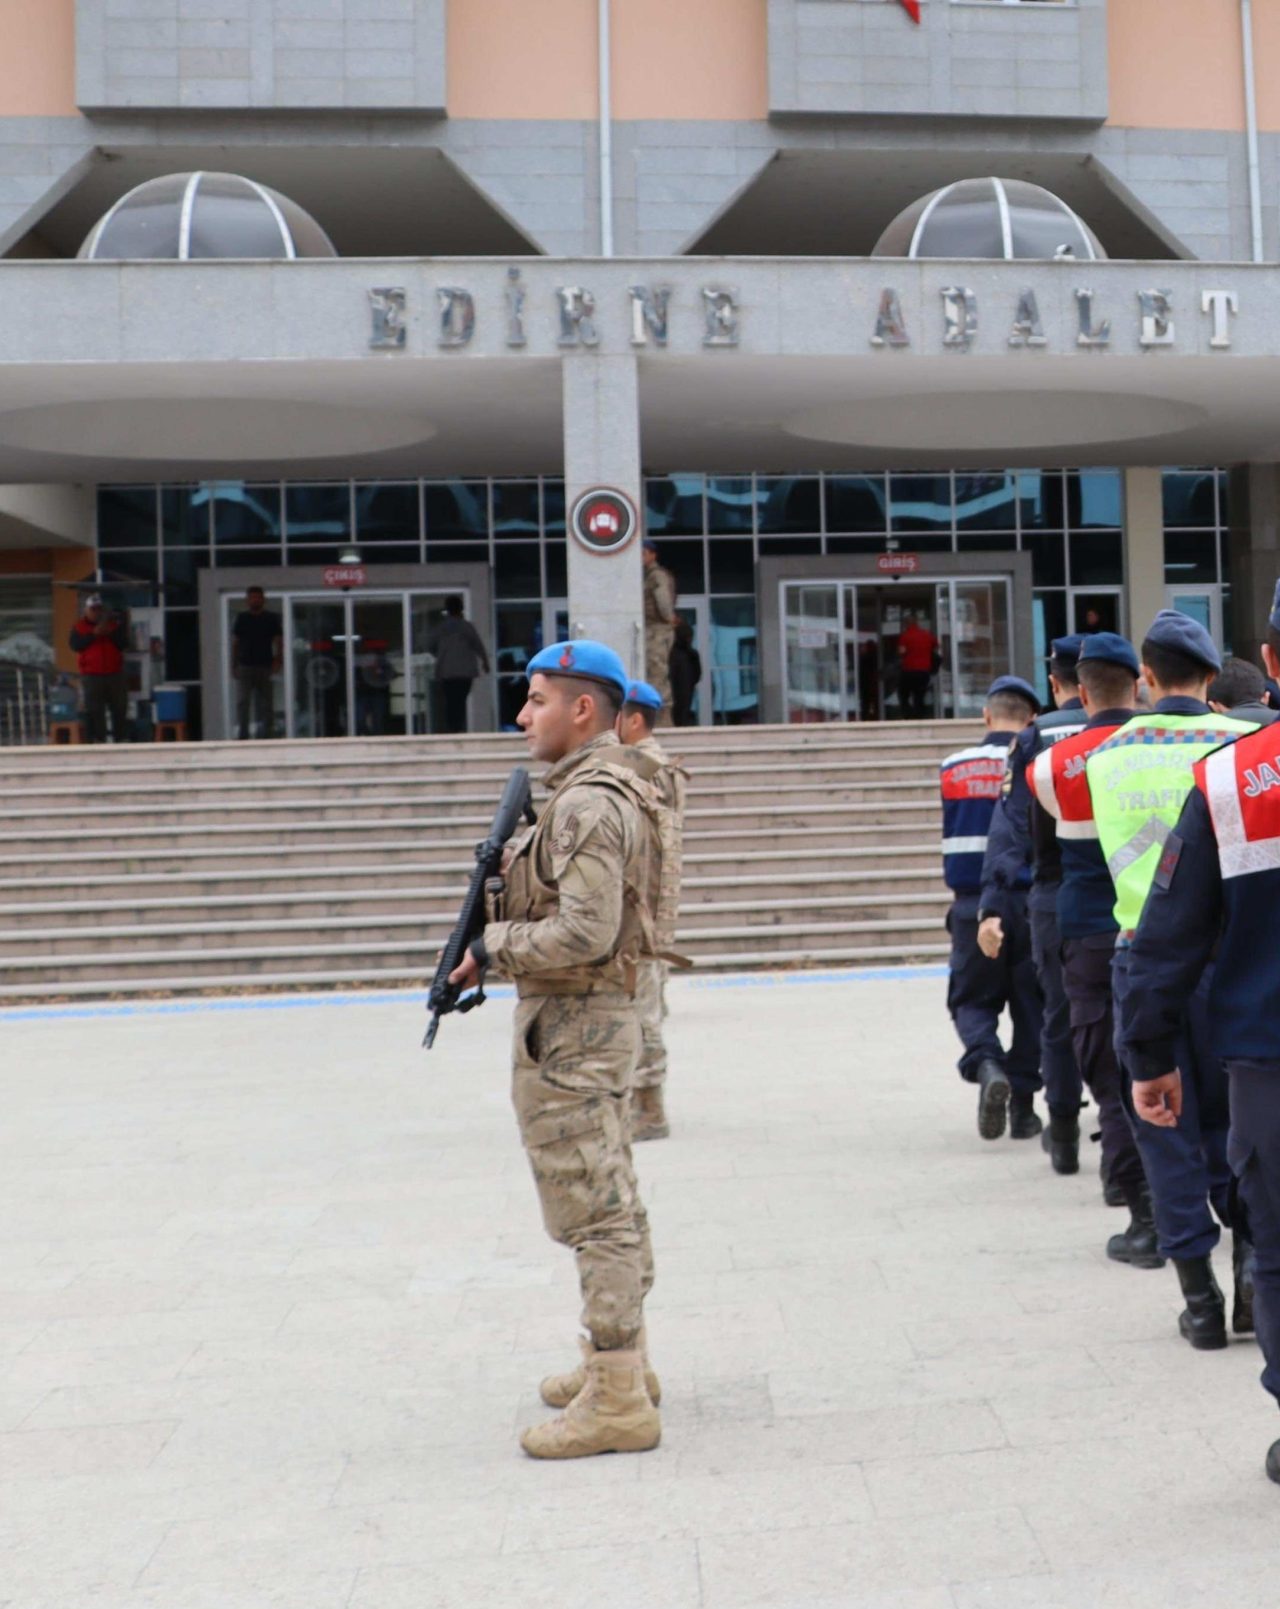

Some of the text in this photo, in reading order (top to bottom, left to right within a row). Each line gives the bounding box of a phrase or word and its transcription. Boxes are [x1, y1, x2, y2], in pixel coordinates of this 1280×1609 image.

[368, 266, 740, 348] EDİRNE
[870, 286, 1239, 348] ADALET
[879, 555, 915, 571] GİRİŞ
